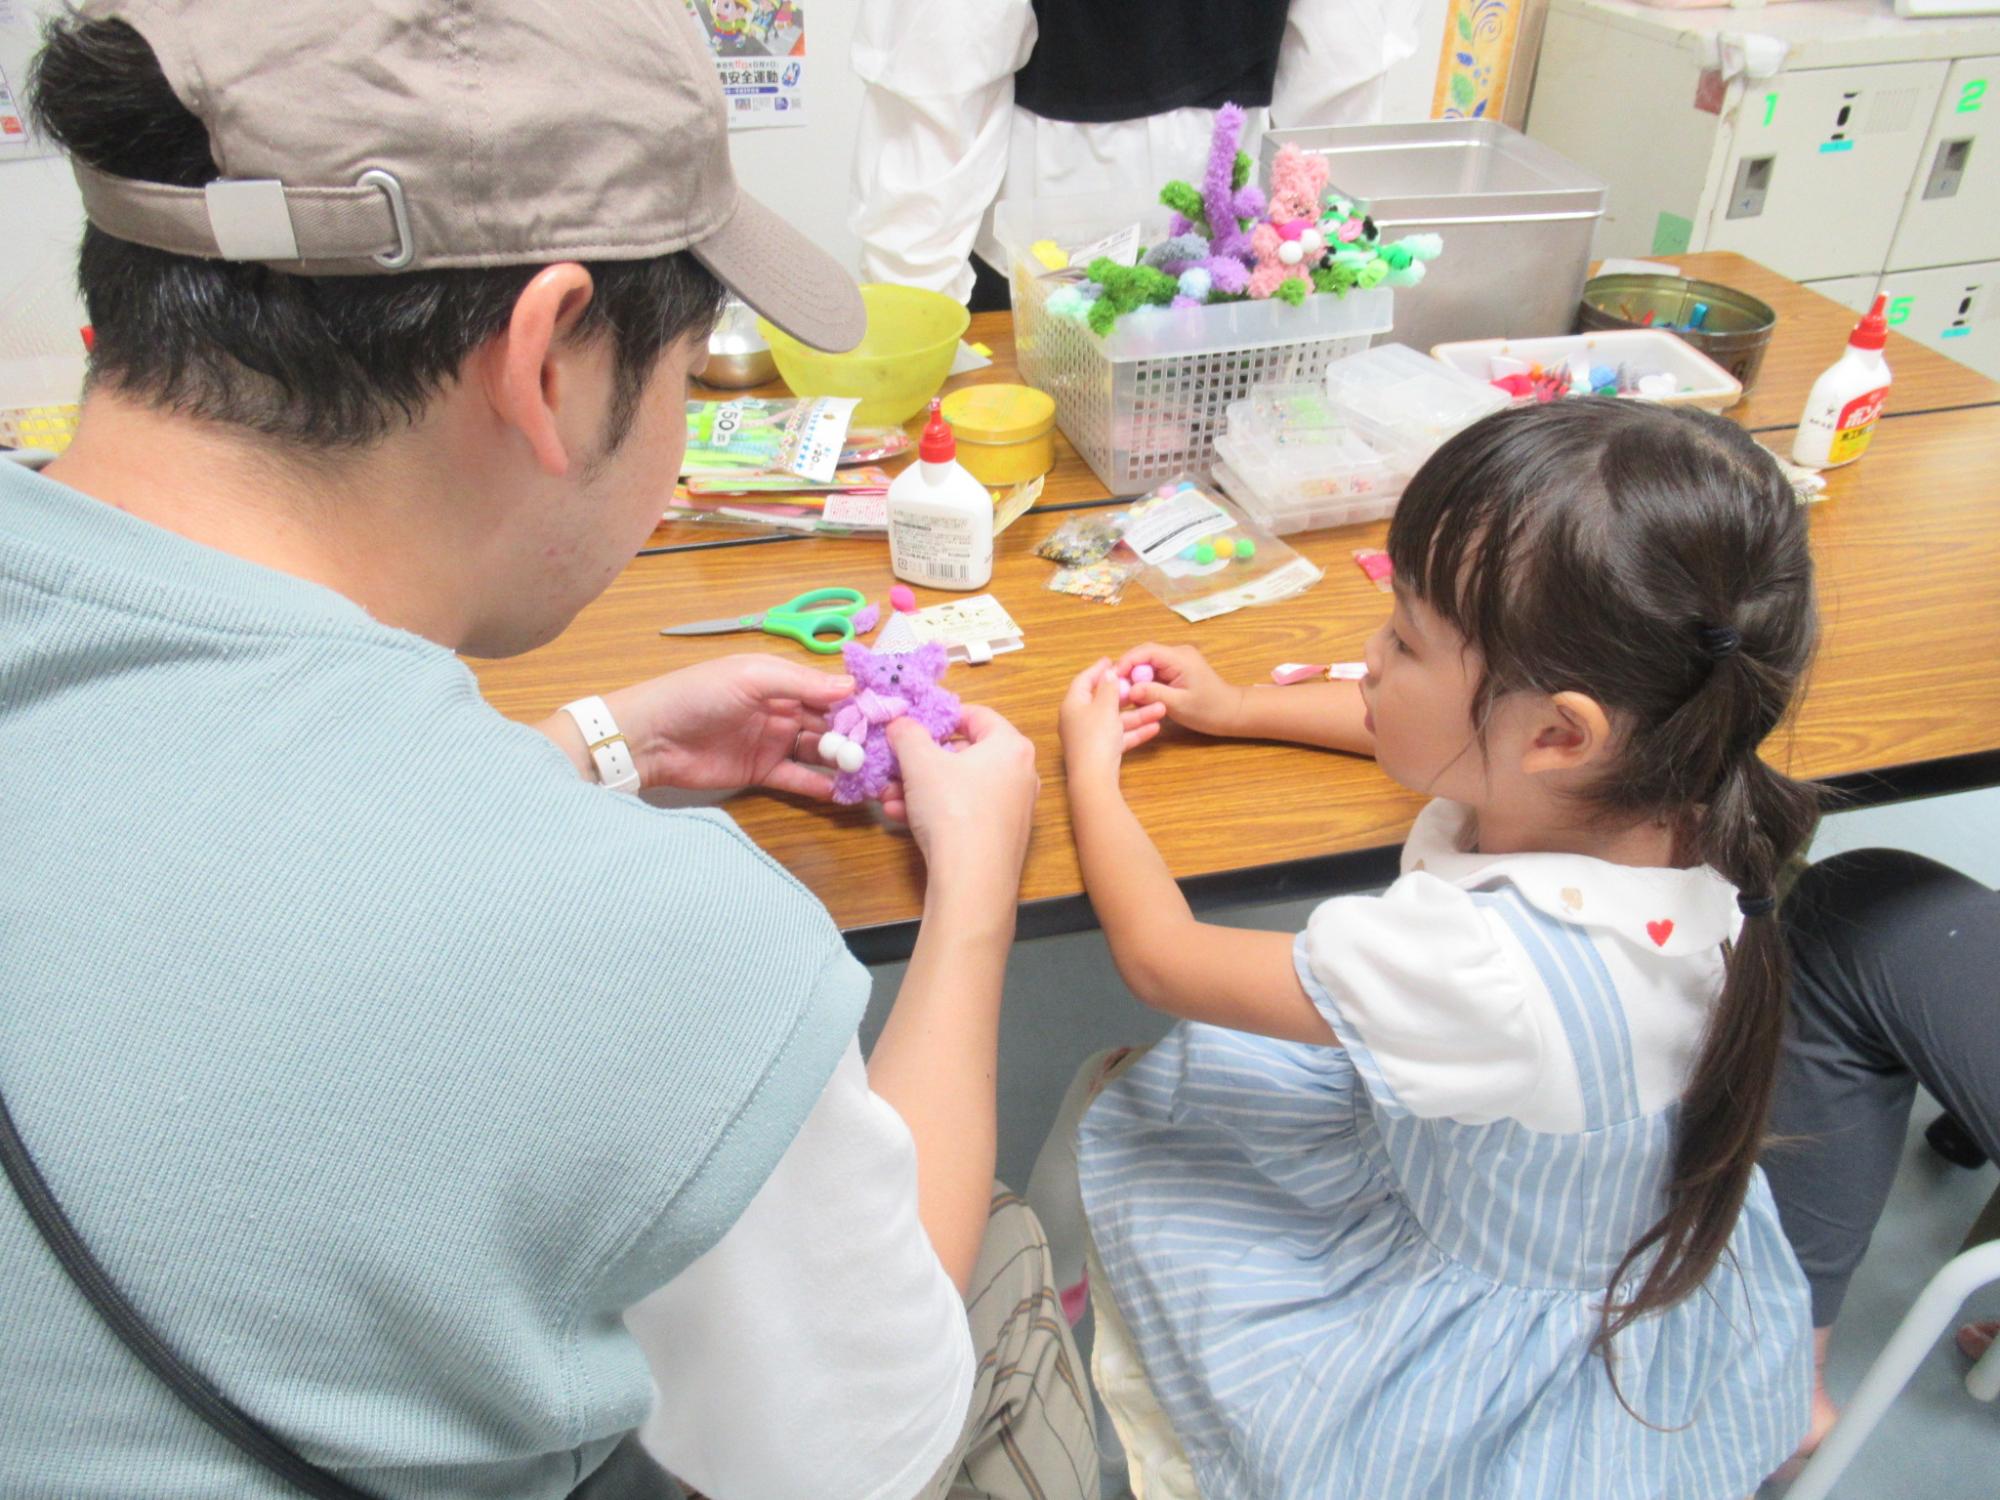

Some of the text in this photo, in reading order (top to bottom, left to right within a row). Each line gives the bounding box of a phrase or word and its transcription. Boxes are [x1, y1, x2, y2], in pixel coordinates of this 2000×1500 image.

[1763, 93, 1778, 127] 1
[1955, 79, 1988, 113] 2
[1888, 296, 1914, 325] 5
[718, 411, 738, 431] 50
